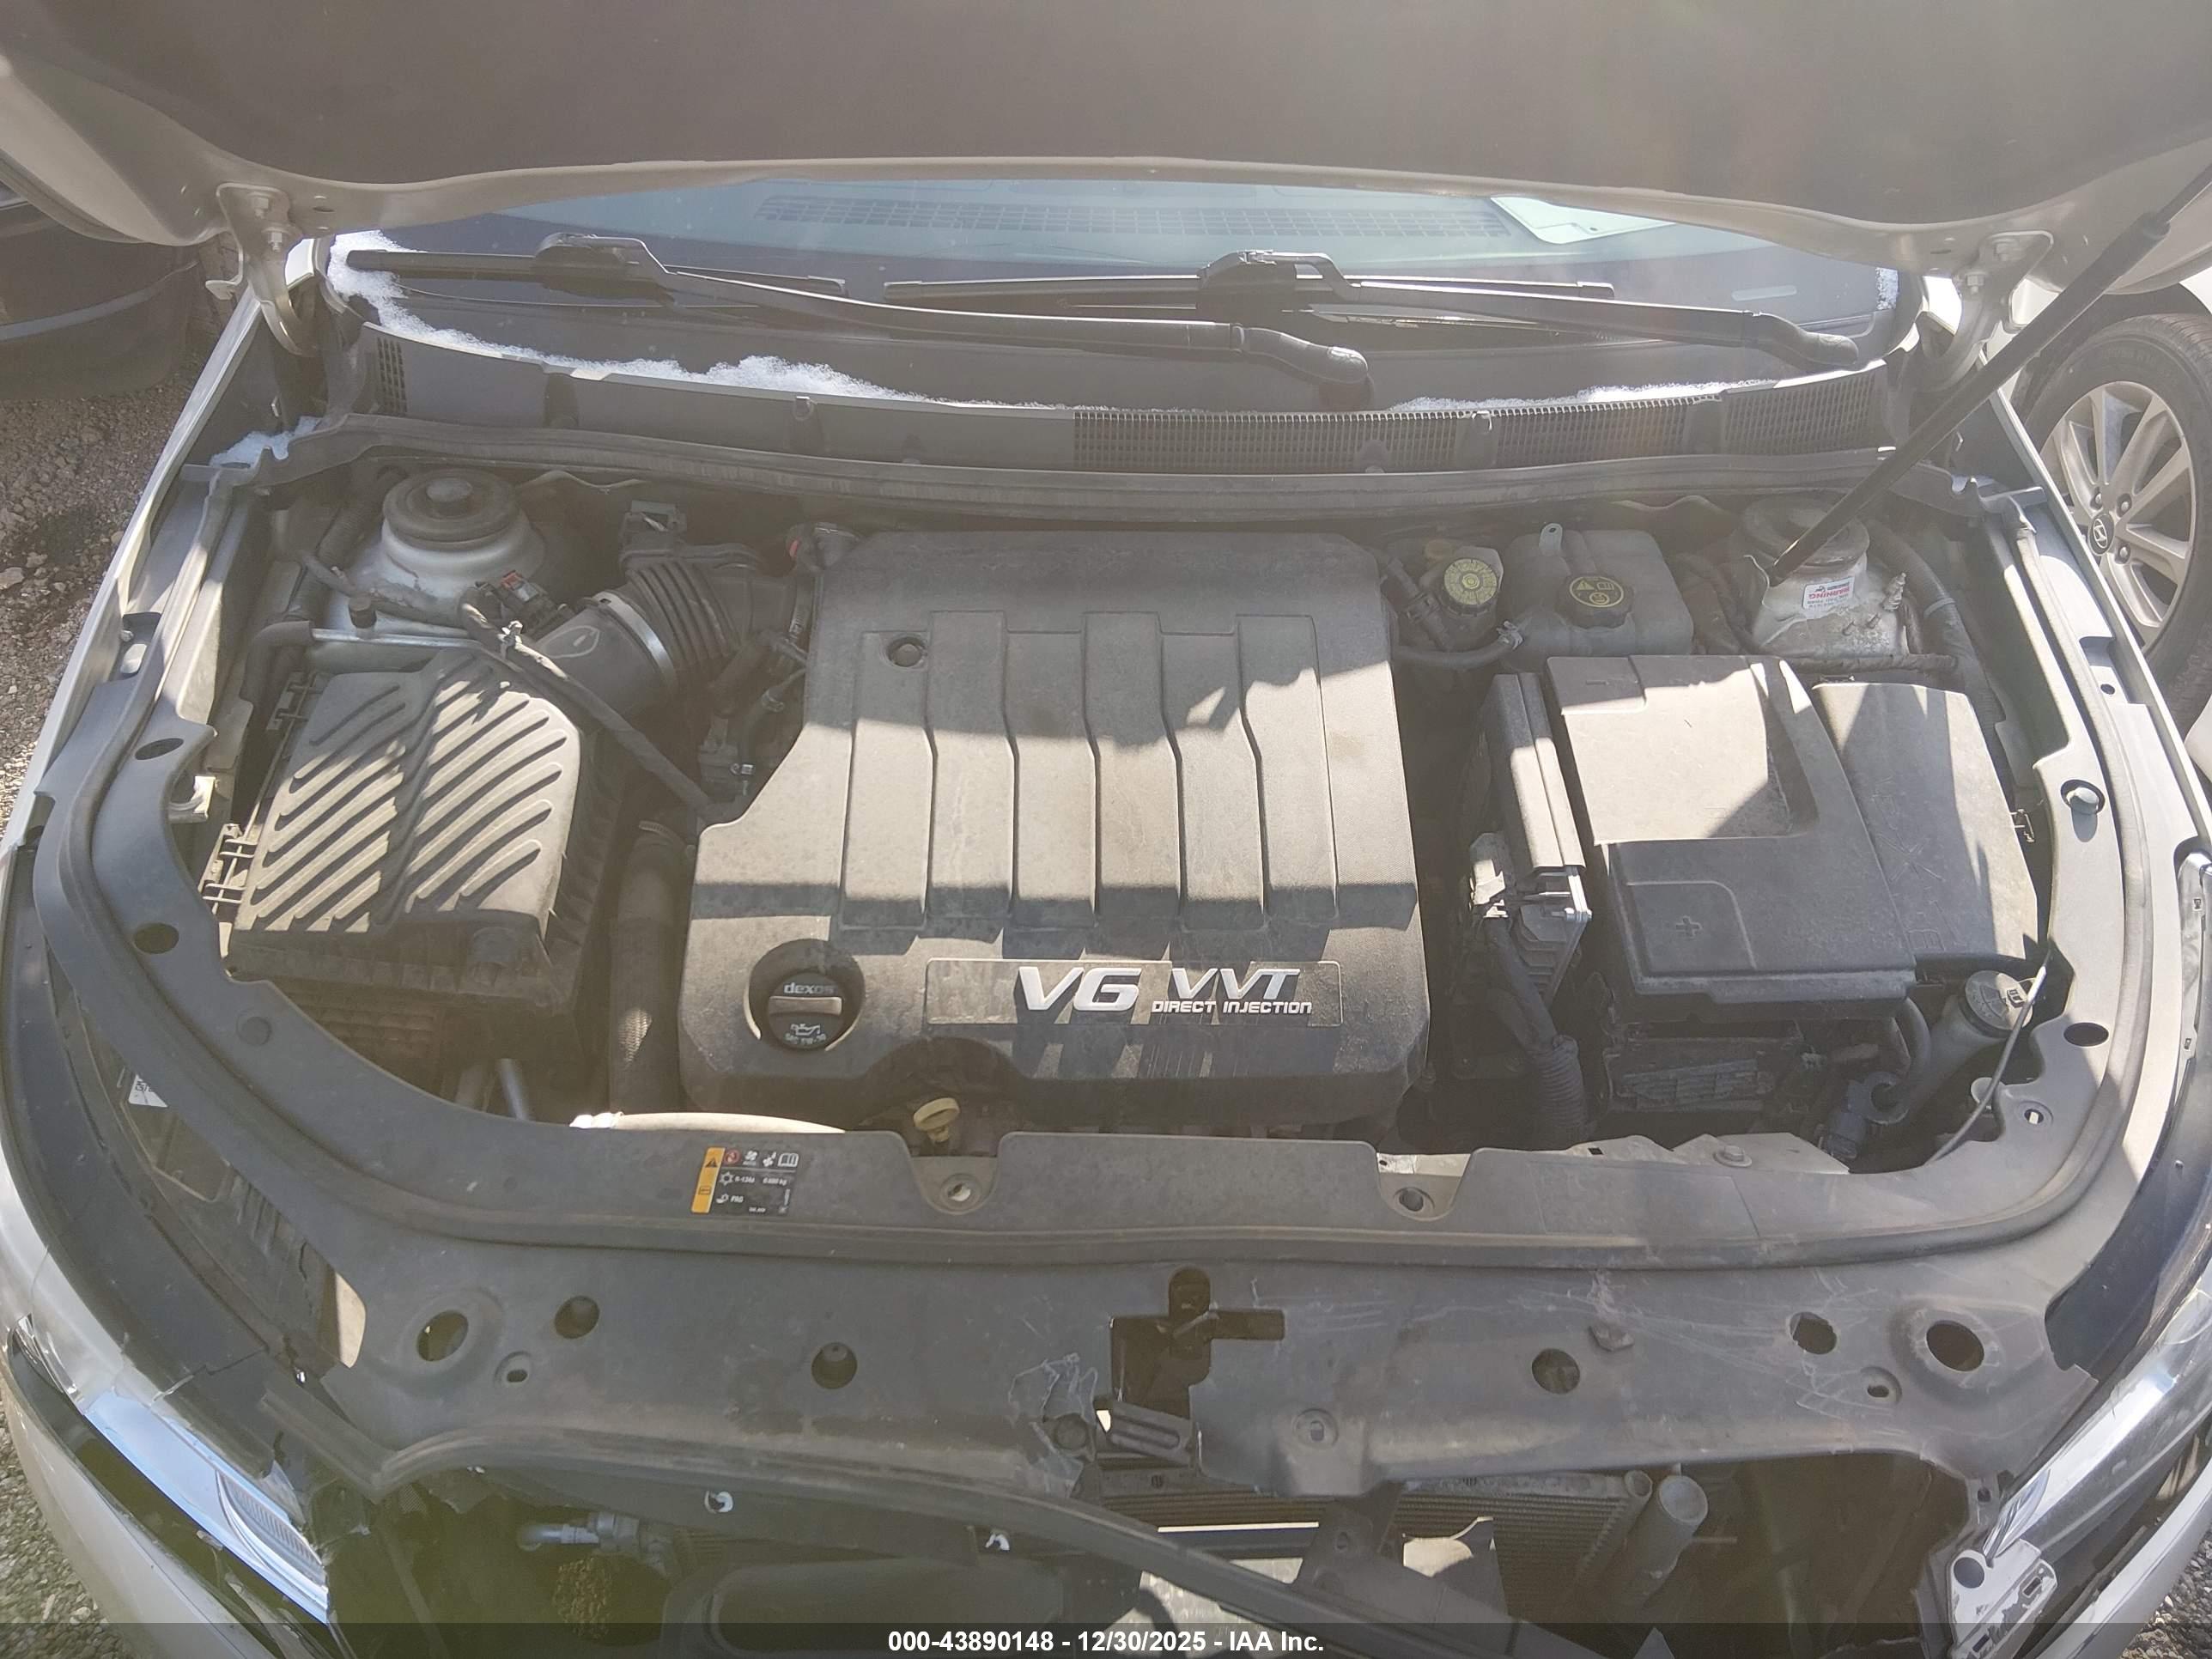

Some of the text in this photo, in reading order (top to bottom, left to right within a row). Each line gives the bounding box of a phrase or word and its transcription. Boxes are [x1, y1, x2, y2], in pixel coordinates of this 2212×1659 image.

[1018, 966, 1301, 1012] V6 VVT
[1152, 1000, 1313, 1015] DIRECT INJECTION
